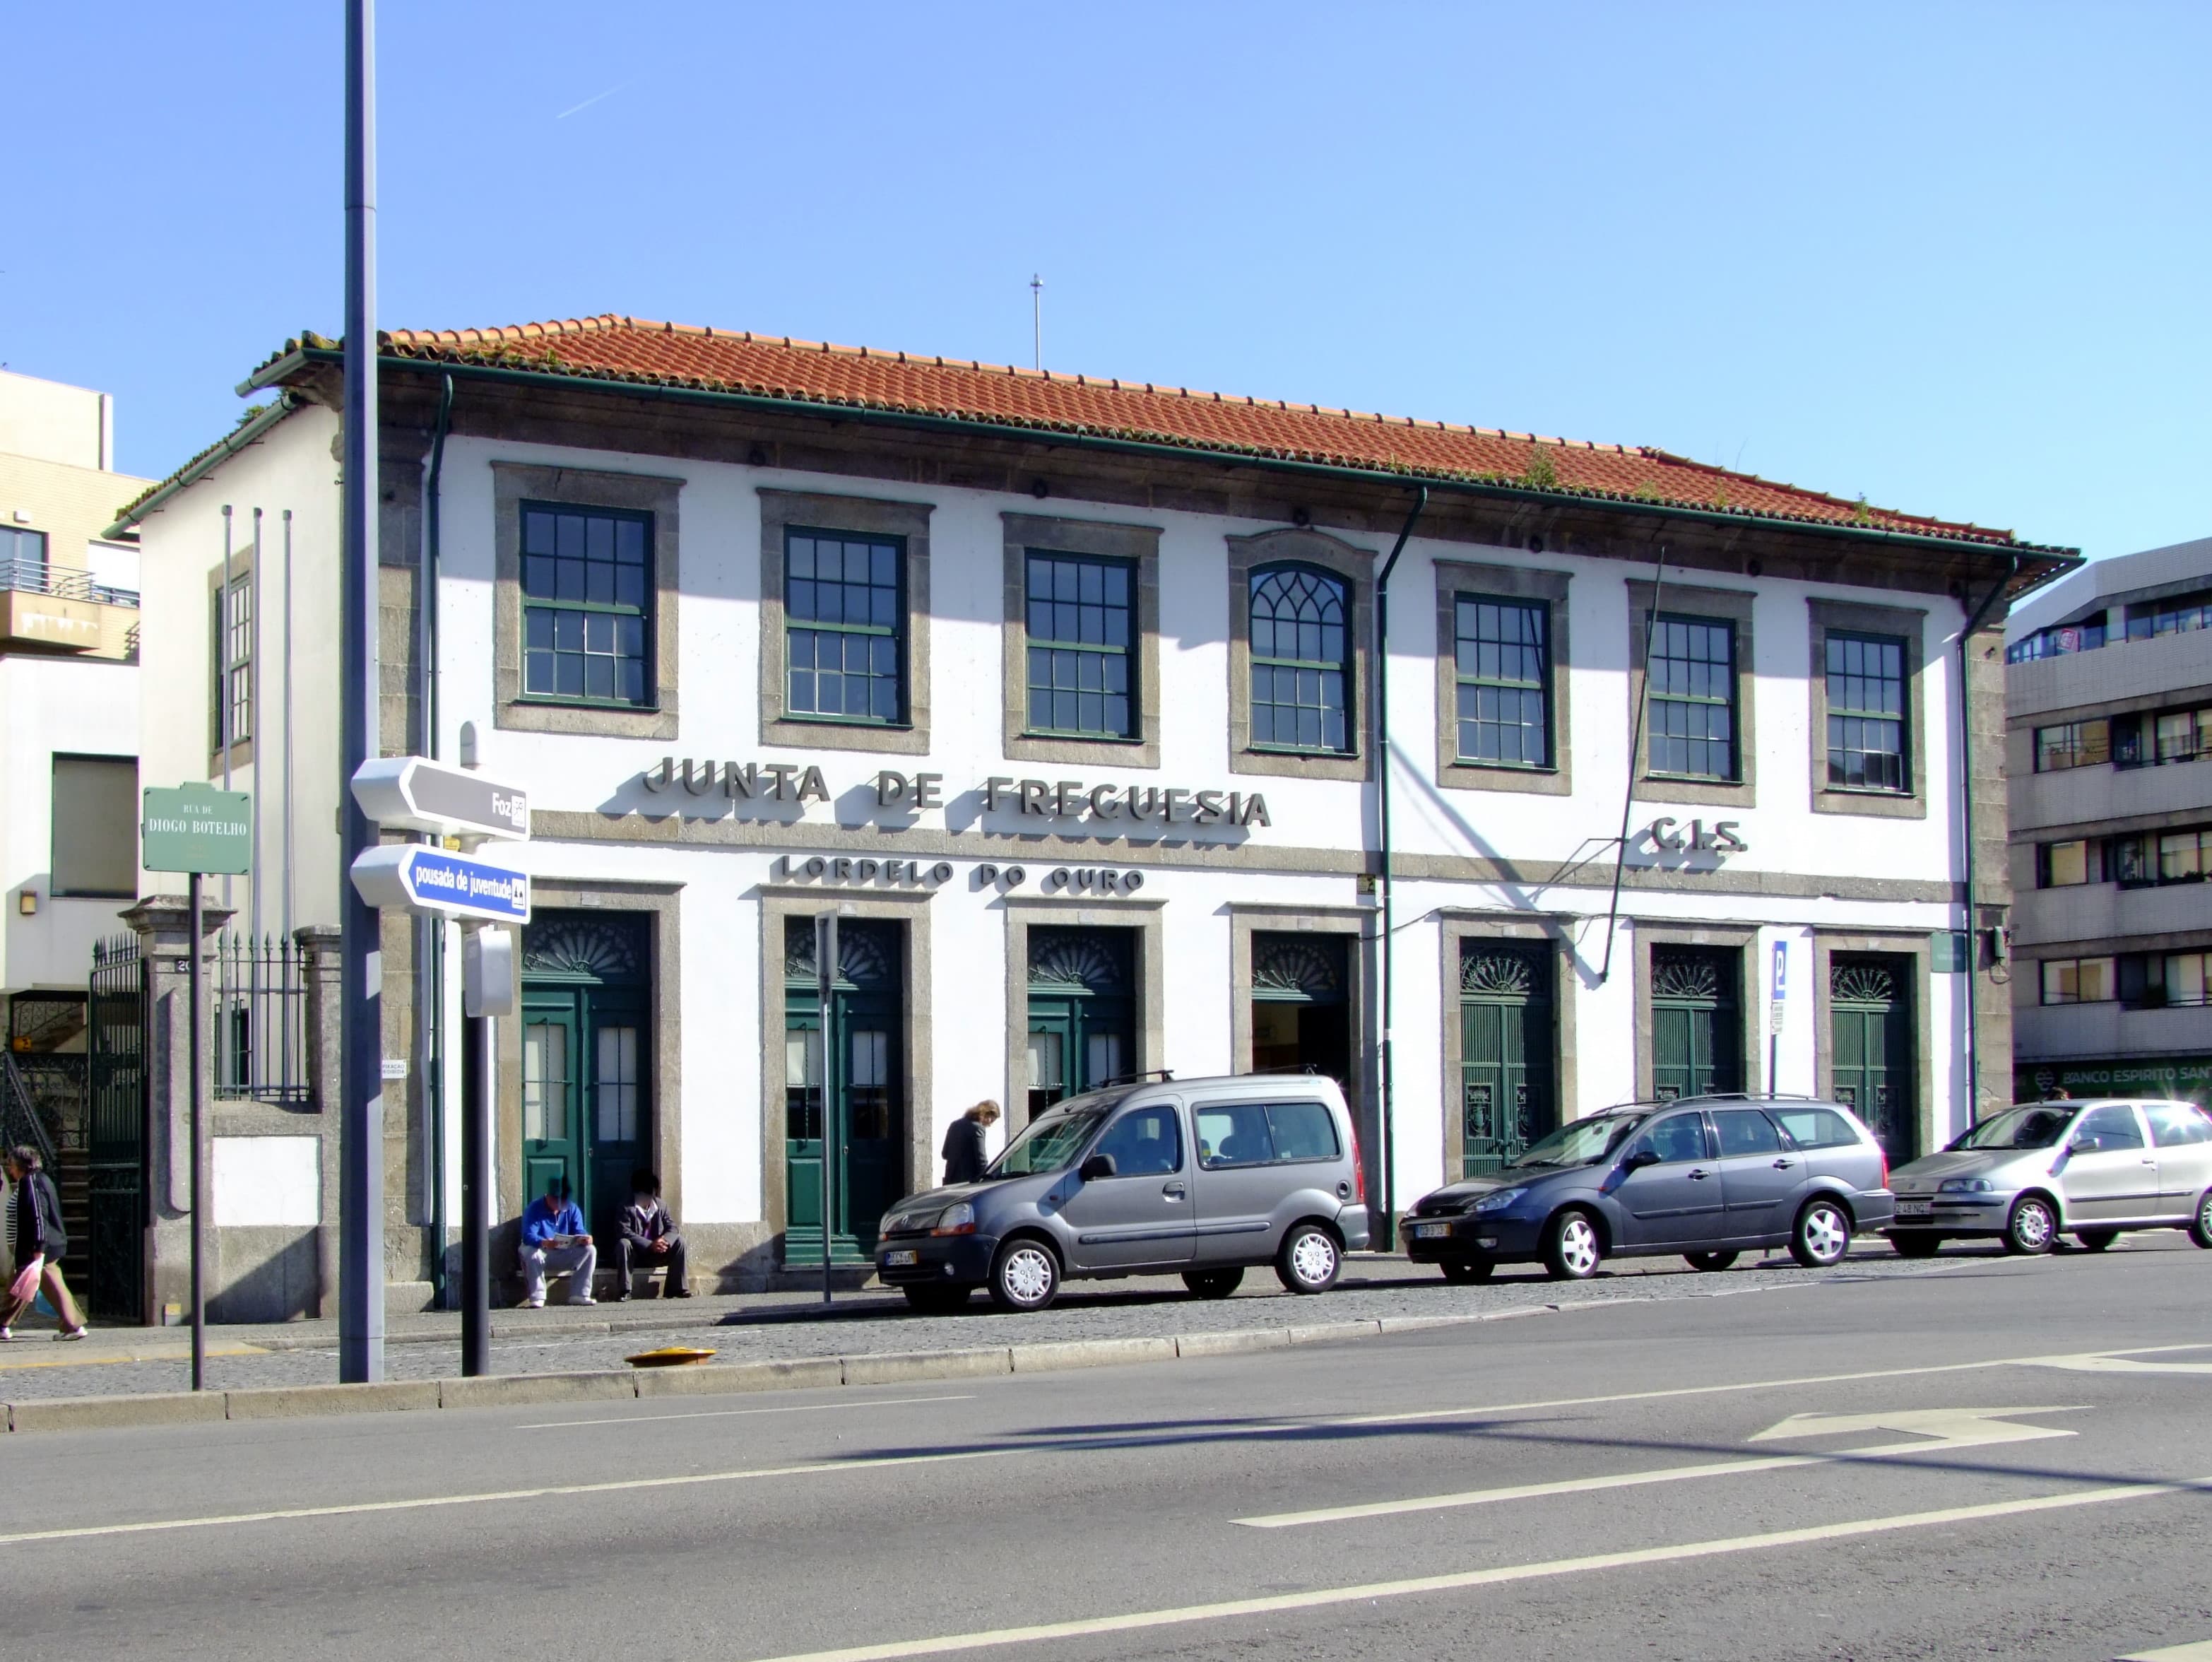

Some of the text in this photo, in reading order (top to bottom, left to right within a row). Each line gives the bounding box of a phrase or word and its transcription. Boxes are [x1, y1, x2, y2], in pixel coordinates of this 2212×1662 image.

[492, 792, 511, 817] Foz
[643, 757, 1272, 827] JUNTA DE FREGUESIA
[183, 804, 213, 815] RUA DE
[149, 818, 247, 836] DIOGO BOTELHO
[415, 866, 512, 900] pousada de juventude
[782, 855, 1145, 890] LORDELO DO OURO
[1775, 950, 1785, 991] P
[2063, 1071, 2109, 1084] BANCO
